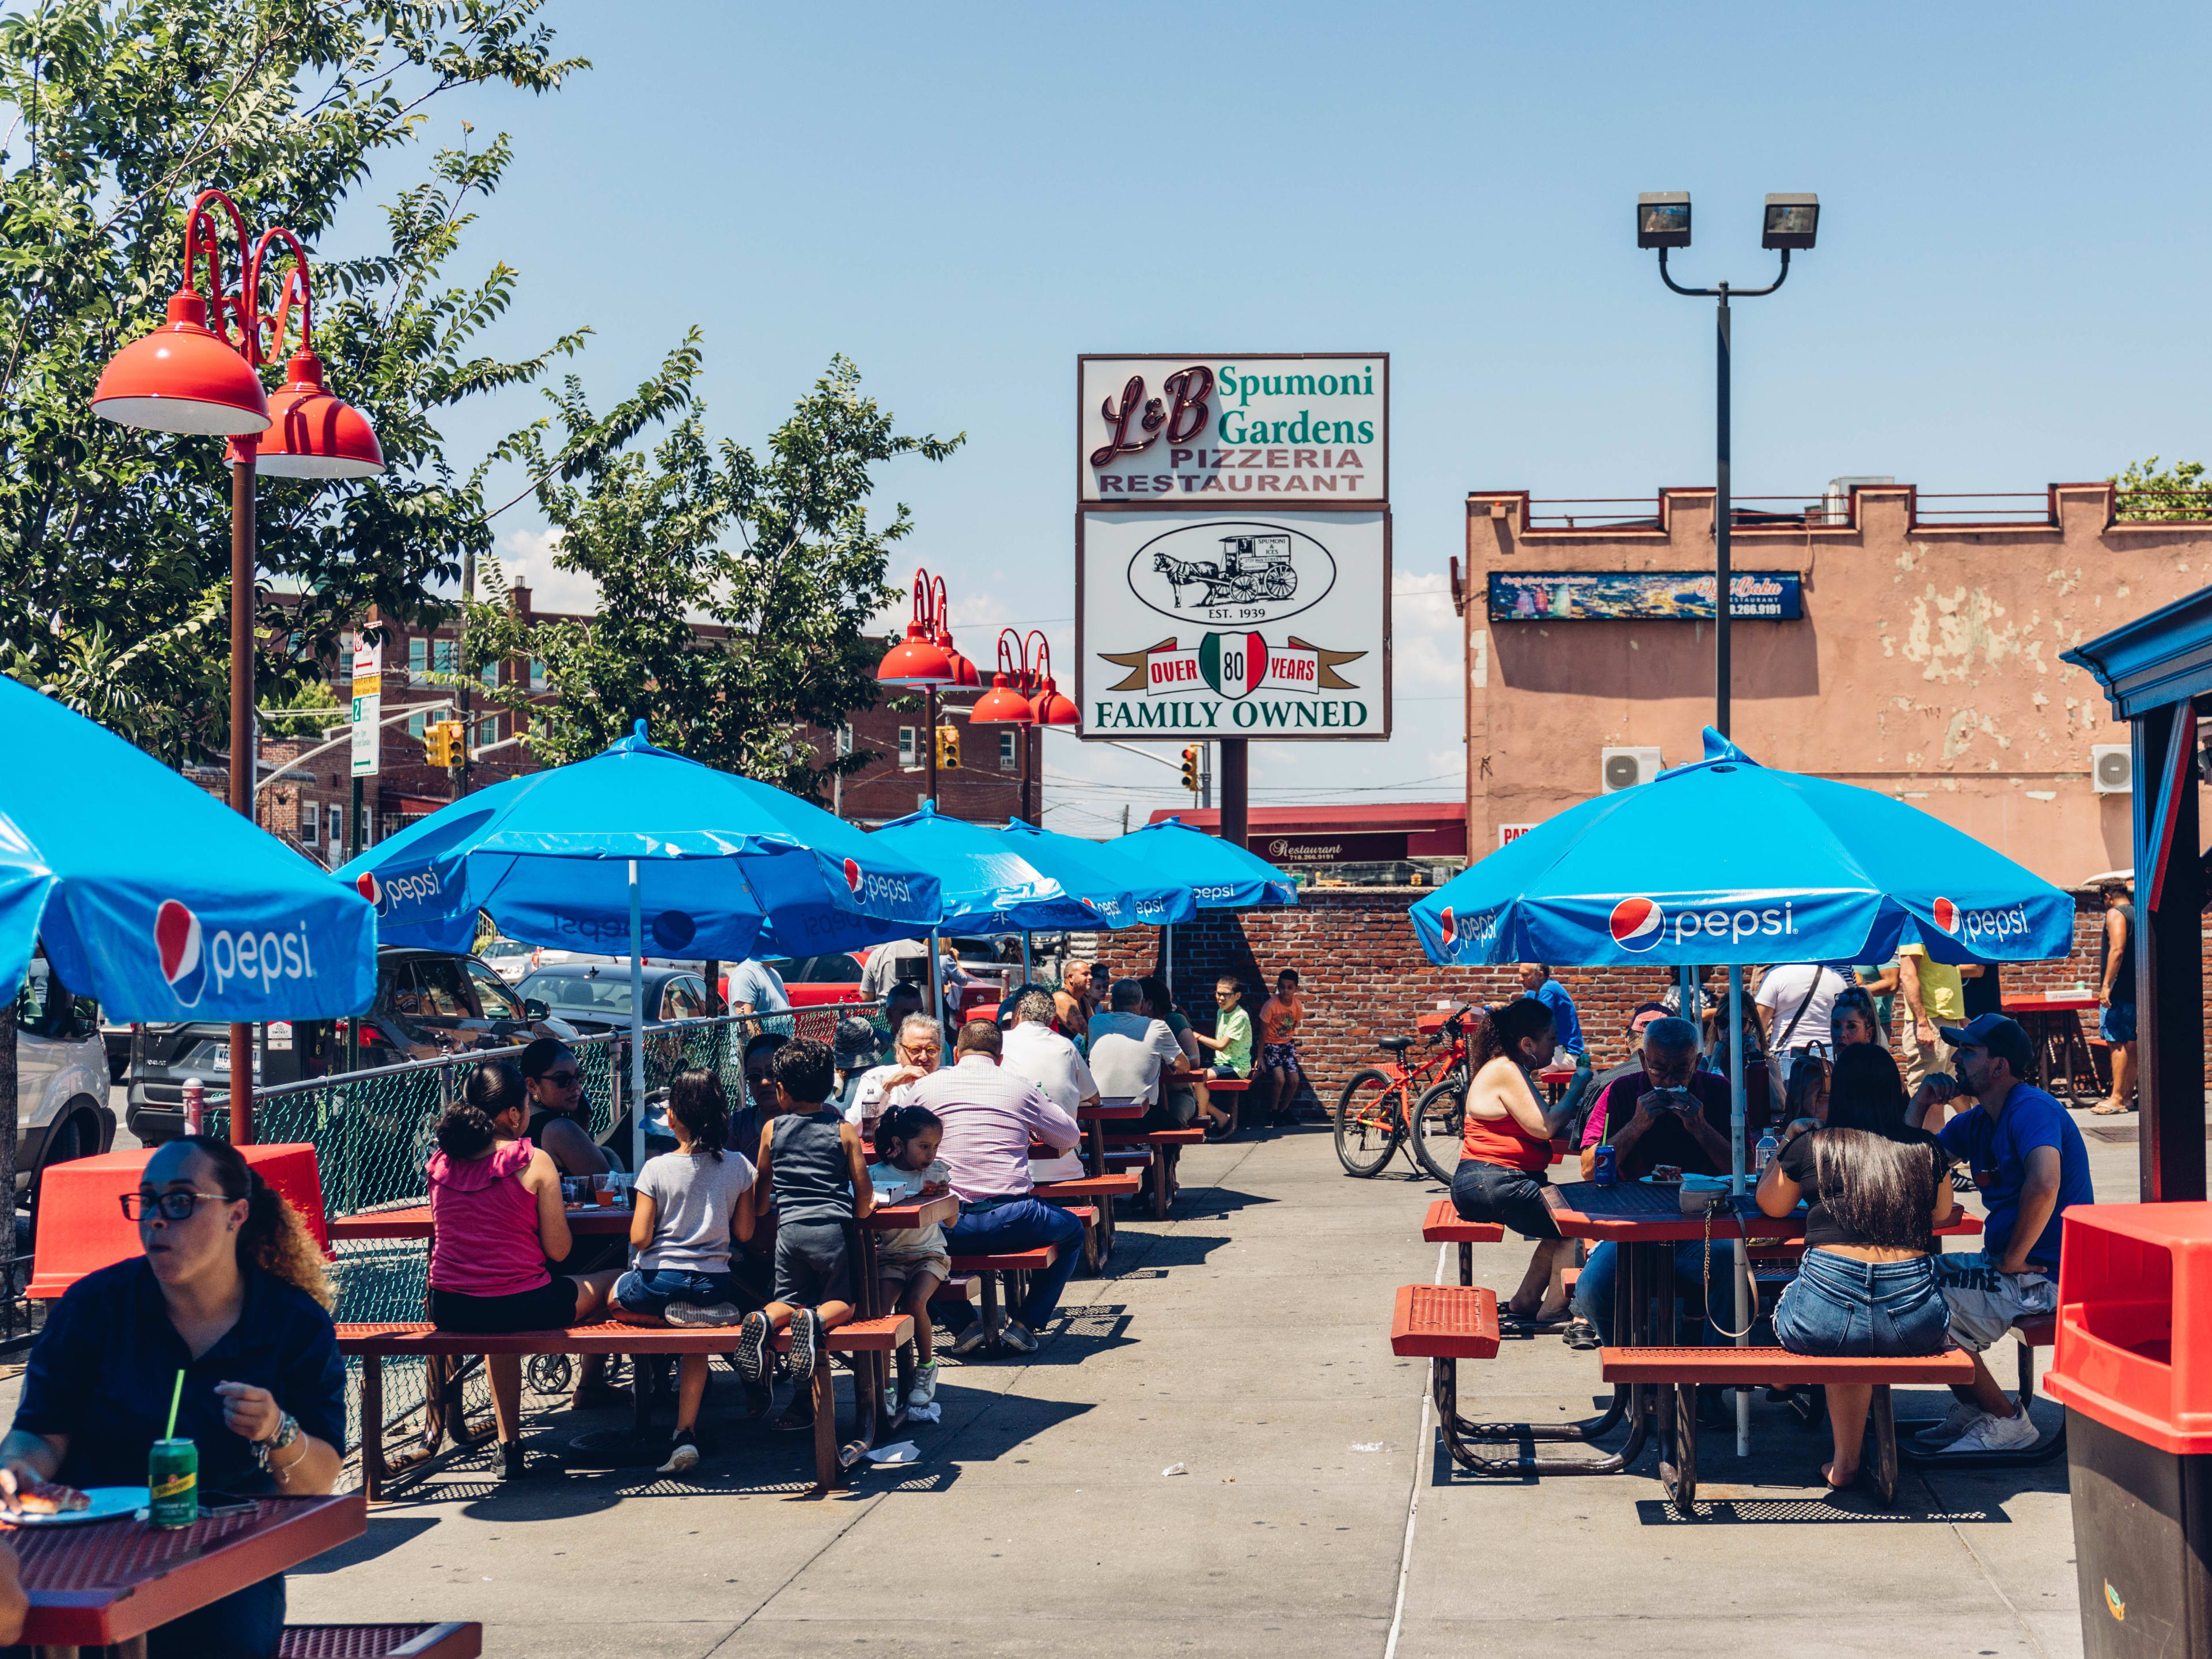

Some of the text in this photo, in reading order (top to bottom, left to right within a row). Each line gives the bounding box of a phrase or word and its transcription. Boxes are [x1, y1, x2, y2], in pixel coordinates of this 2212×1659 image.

[1219, 365, 1375, 407] Spumoni
[1218, 410, 1375, 445] Gardens
[1170, 449, 1364, 469] PIZZERIA
[1100, 475, 1365, 493] RESTAURANT
[1735, 576, 1783, 597] Baku
[1209, 608, 1266, 619] EST. 1939
[1151, 652, 1315, 684] OVER 80 YEARS
[355, 700, 359, 720] 2
[1094, 700, 1368, 728] FAMILY OWNED
[1269, 839, 1343, 857] Restaurant
[386, 866, 440, 909] pepsi
[868, 873, 912, 906] pepsi
[1135, 896, 1164, 918] epsi
[1967, 903, 2029, 942] pepsi
[1461, 907, 1497, 949] pepsi
[1676, 902, 1793, 945] pepsi
[211, 921, 313, 994] pepsi
